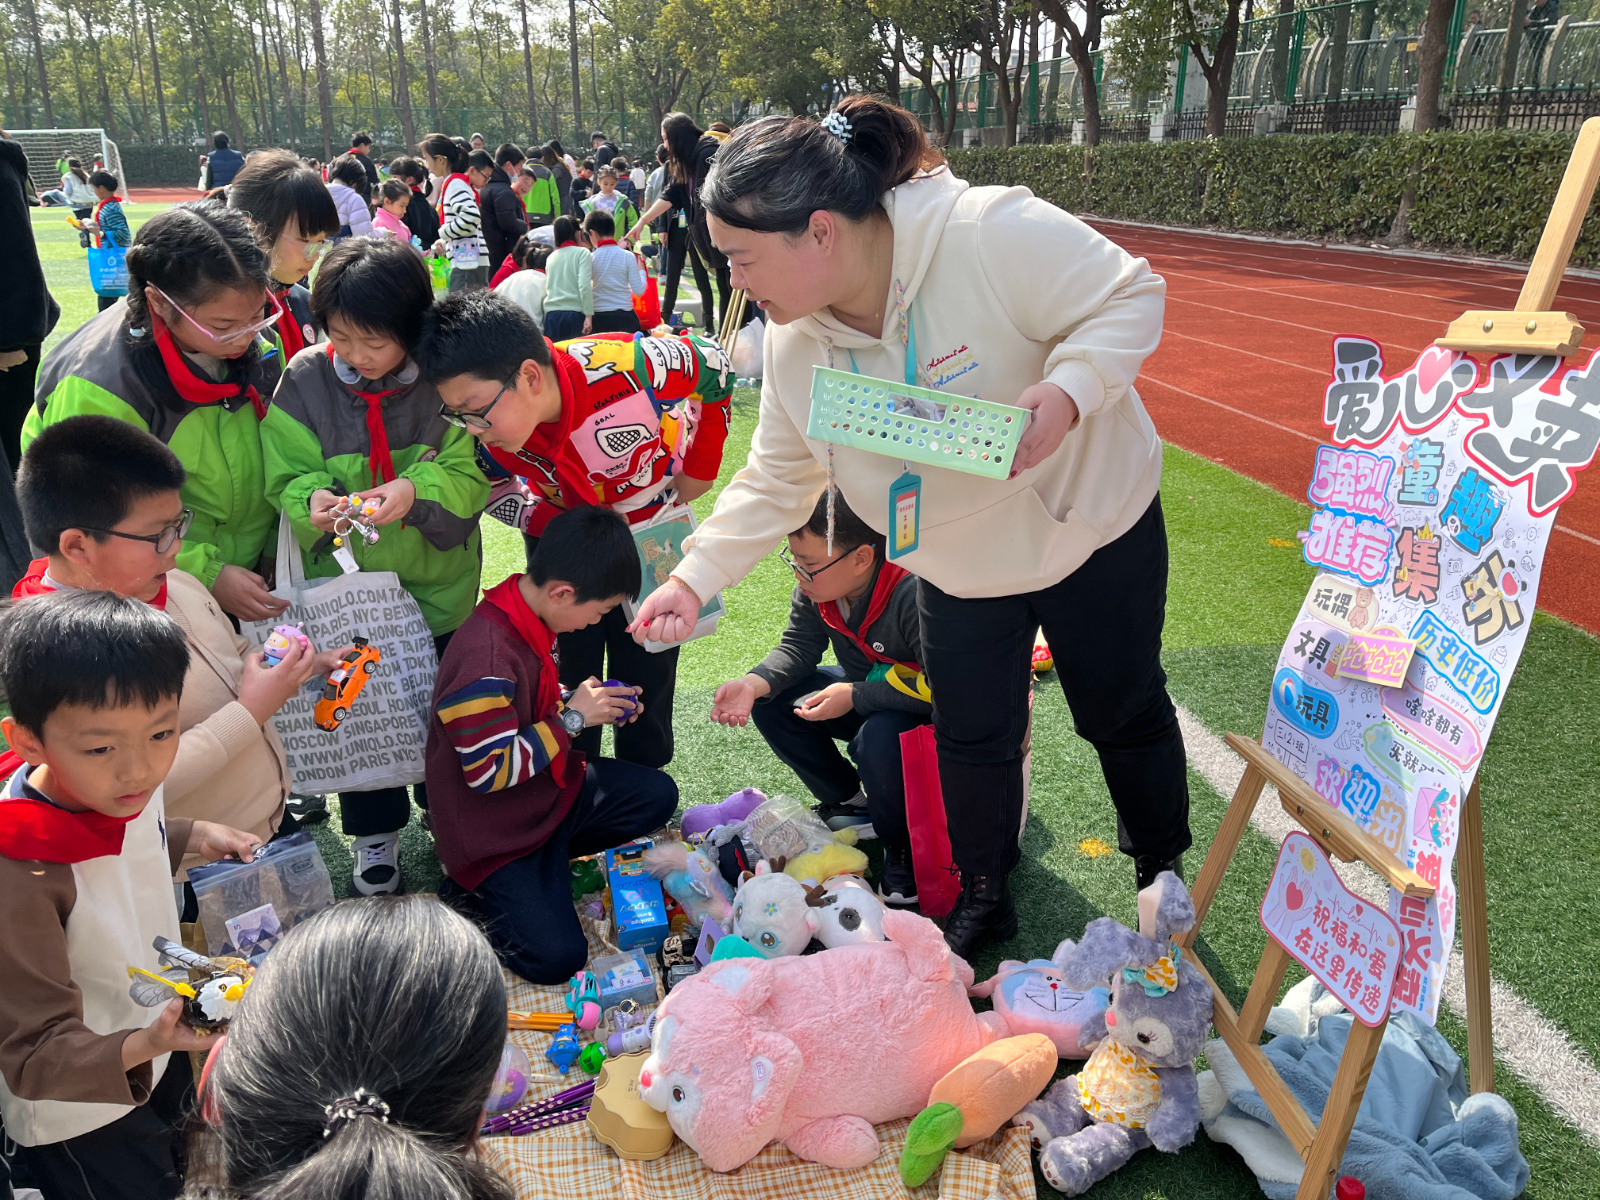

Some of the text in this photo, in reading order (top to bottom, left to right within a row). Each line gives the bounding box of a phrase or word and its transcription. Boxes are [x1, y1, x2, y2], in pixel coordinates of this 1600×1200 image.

[595, 413, 616, 426] GOAL
[1324, 340, 1600, 508] 爱心义卖
[1310, 448, 1393, 516] 强烈
[1306, 511, 1393, 582] 推荐
[272, 588, 388, 622] W.UNIQLO.COM
[1313, 587, 1352, 622] 玩偶
[311, 612, 350, 639] PARIS
[352, 607, 379, 624] NYC
[1293, 630, 1331, 669] 文具
[1342, 640, 1410, 677] 抢抢抢
[1412, 616, 1496, 704] 历史低价
[371, 681, 397, 697] NYC
[1440, 693, 1470, 714] HAPPY!
[273, 699, 316, 716] OND
[1295, 693, 1330, 731] 玩具
[1405, 697, 1464, 746] 啥啥都有
[344, 714, 419, 739] SINGAPORE
[293, 765, 346, 783] ONDON
[349, 752, 391, 773] PARIS
[392, 748, 418, 763] NYC
[299, 731, 424, 766] WWW.UNIQLO.COM
[1389, 740, 1446, 774] 买就
[1312, 899, 1387, 982] 祝福和爱
[1293, 926, 1382, 1016] 在这里传递
